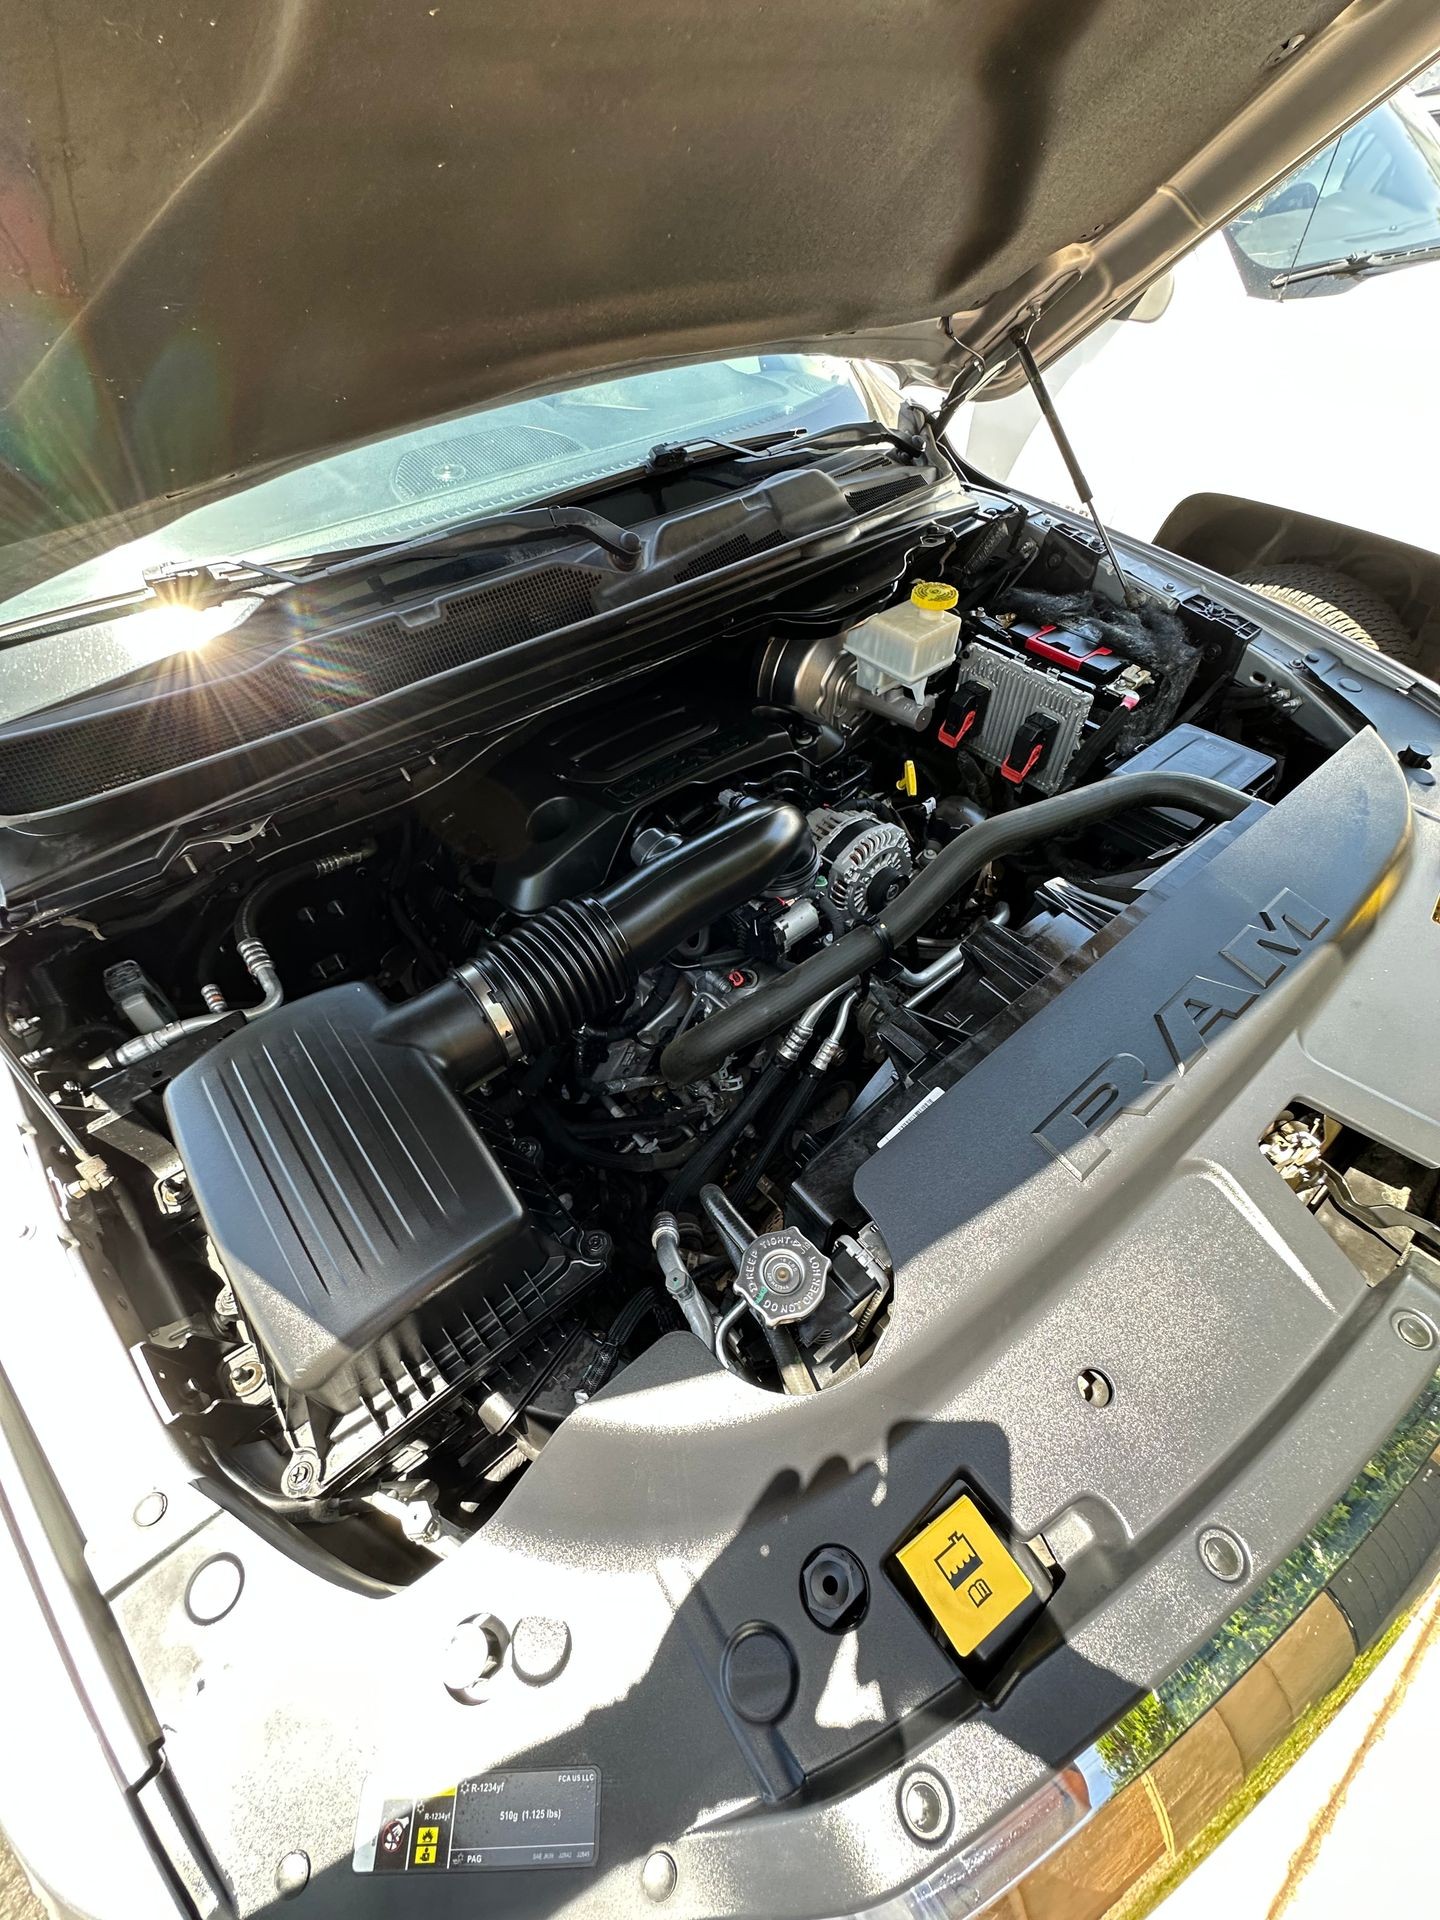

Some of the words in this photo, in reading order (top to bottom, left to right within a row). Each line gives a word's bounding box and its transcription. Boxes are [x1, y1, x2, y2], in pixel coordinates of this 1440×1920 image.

[1031, 887, 1330, 1182] RAM
[746, 1250, 758, 1280] KEEP
[760, 1237, 791, 1249] TIGHT
[809, 1256, 821, 1276] HOT
[802, 1279, 821, 1305] OPEN
[763, 1300, 778, 1312] DO
[781, 1301, 801, 1313] NOT
[471, 1782, 504, 1794] R-1234yf
[424, 1812, 451, 1822] R-1234yf
[500, 1811, 519, 1822] 510g
[522, 1809, 545, 1821] (1.125
[546, 1809, 561, 1820] lbs)
[467, 1855, 482, 1863] PAG
